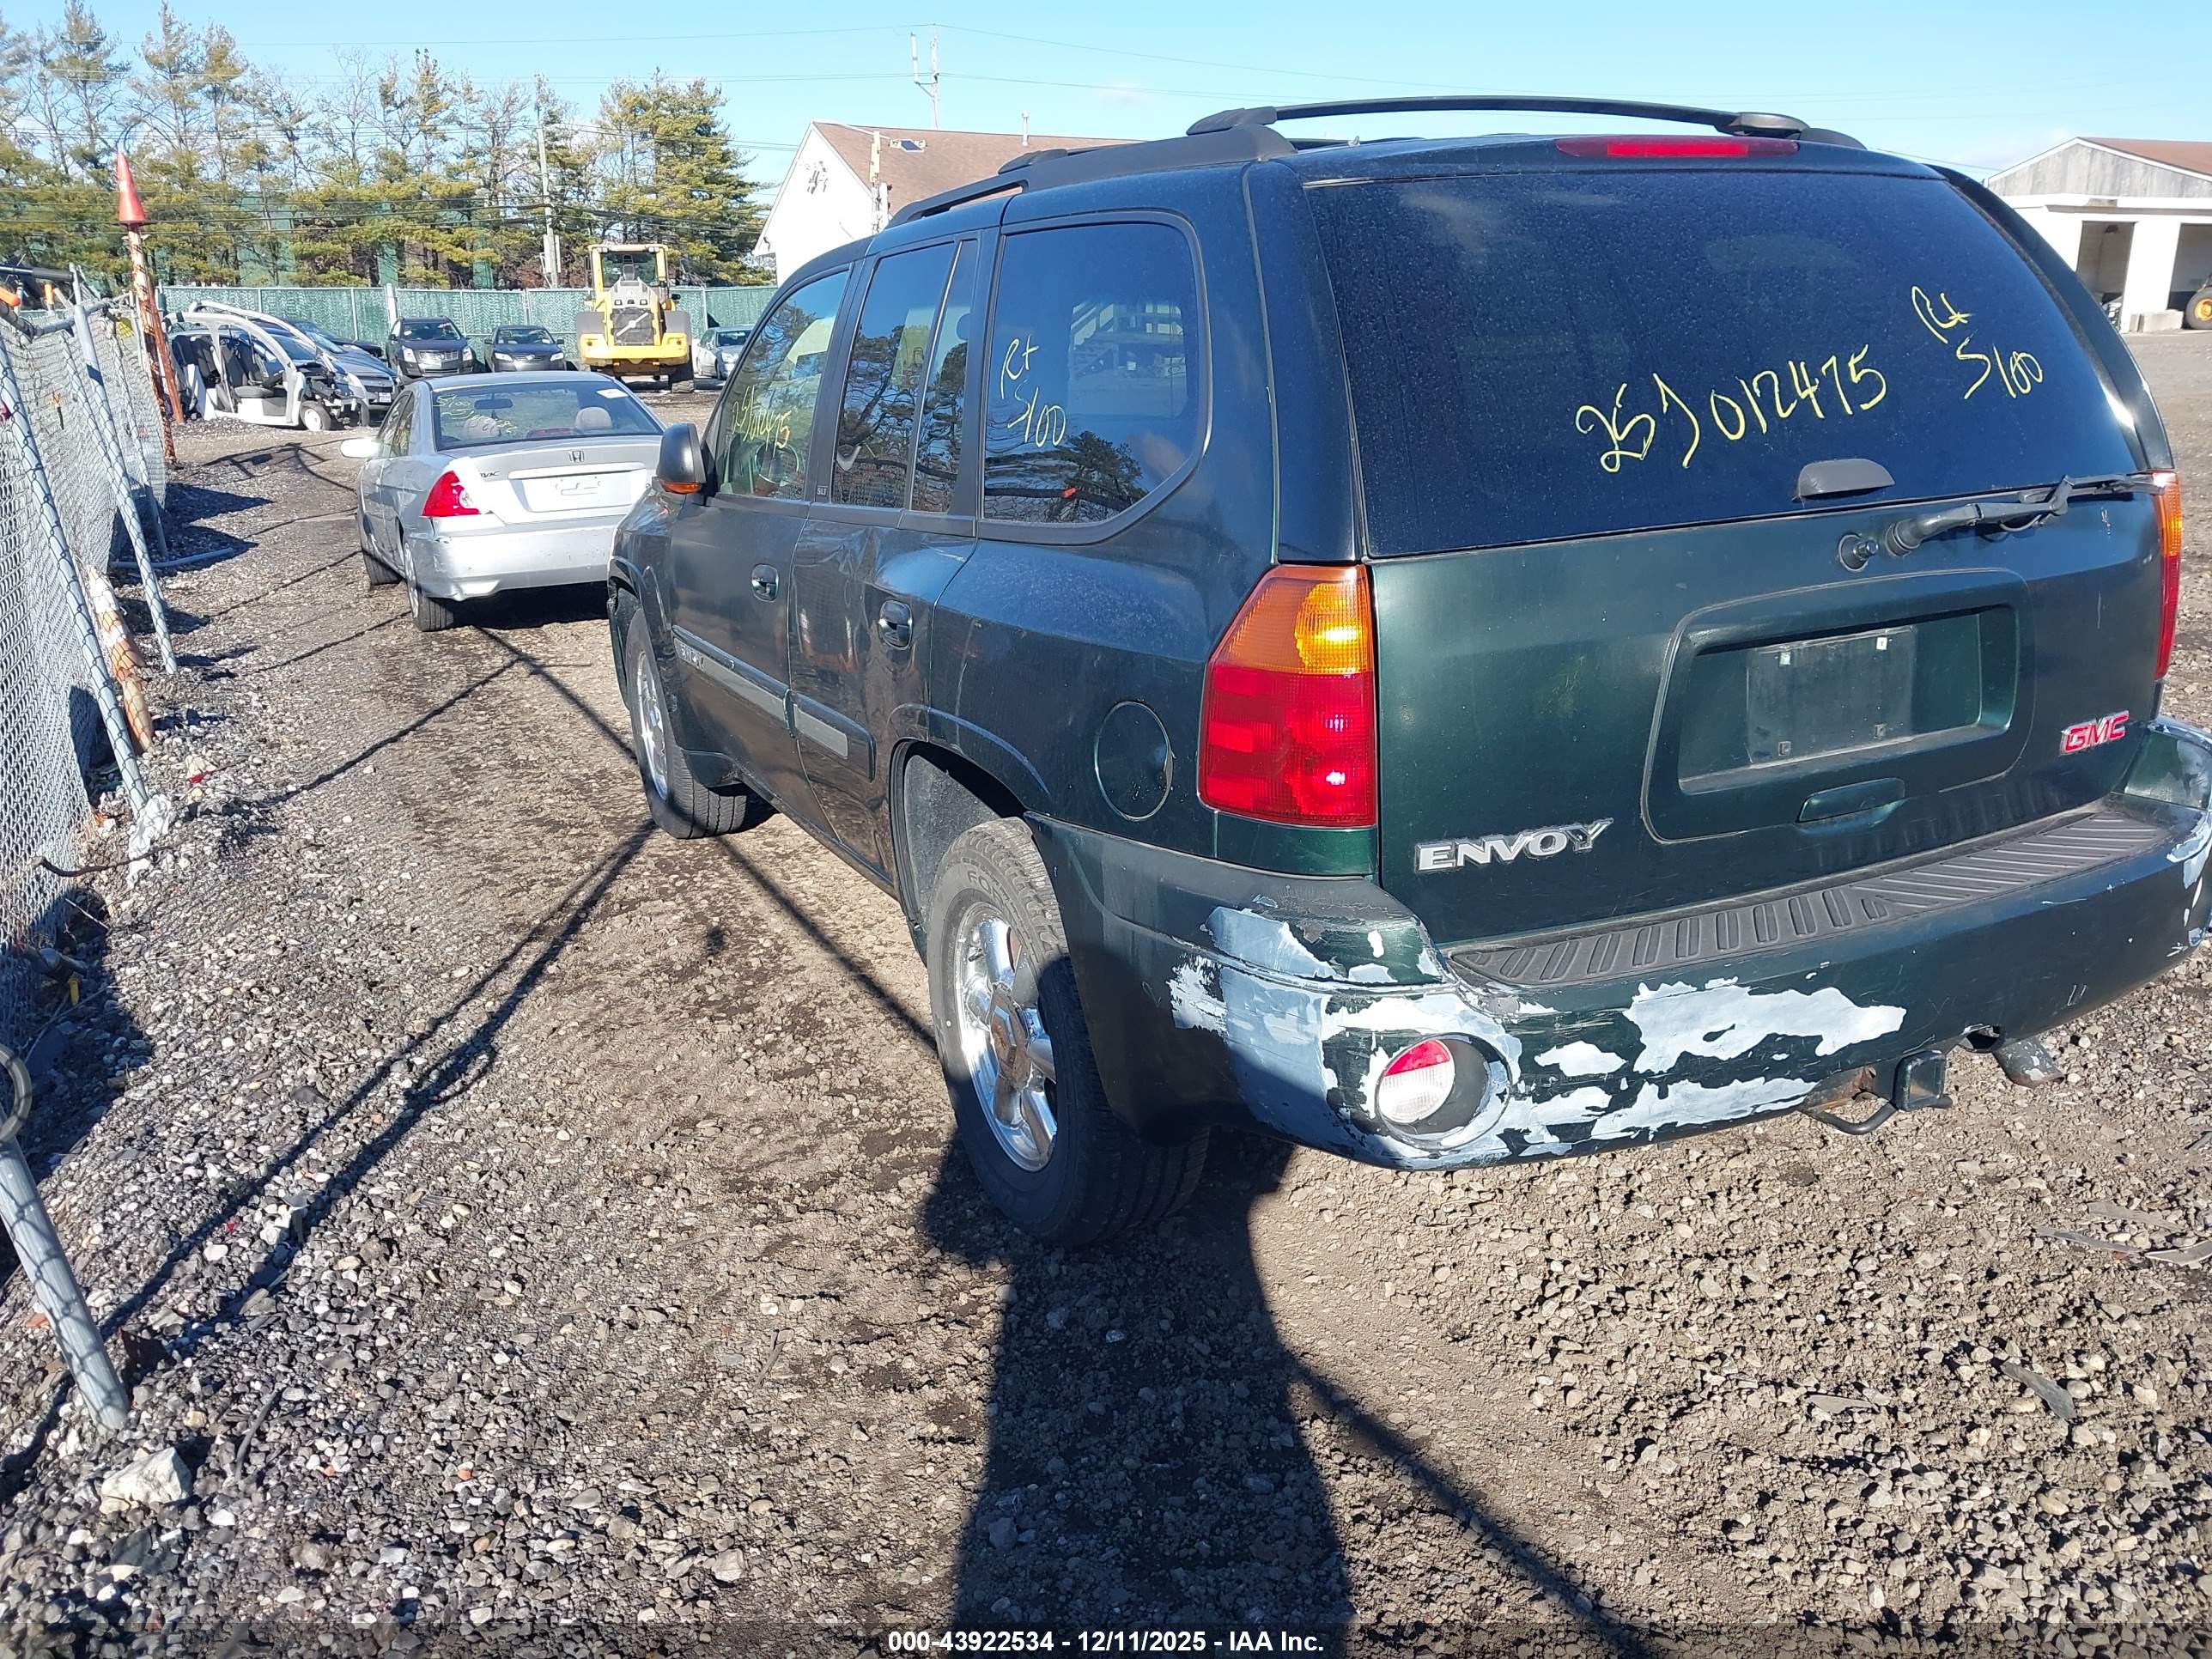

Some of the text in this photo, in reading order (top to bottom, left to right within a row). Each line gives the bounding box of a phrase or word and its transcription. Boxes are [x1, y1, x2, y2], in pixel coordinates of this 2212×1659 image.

[1008, 380, 1066, 447] S100
[2061, 710, 2130, 755] GMC
[1415, 817, 1614, 872] ENVOY
